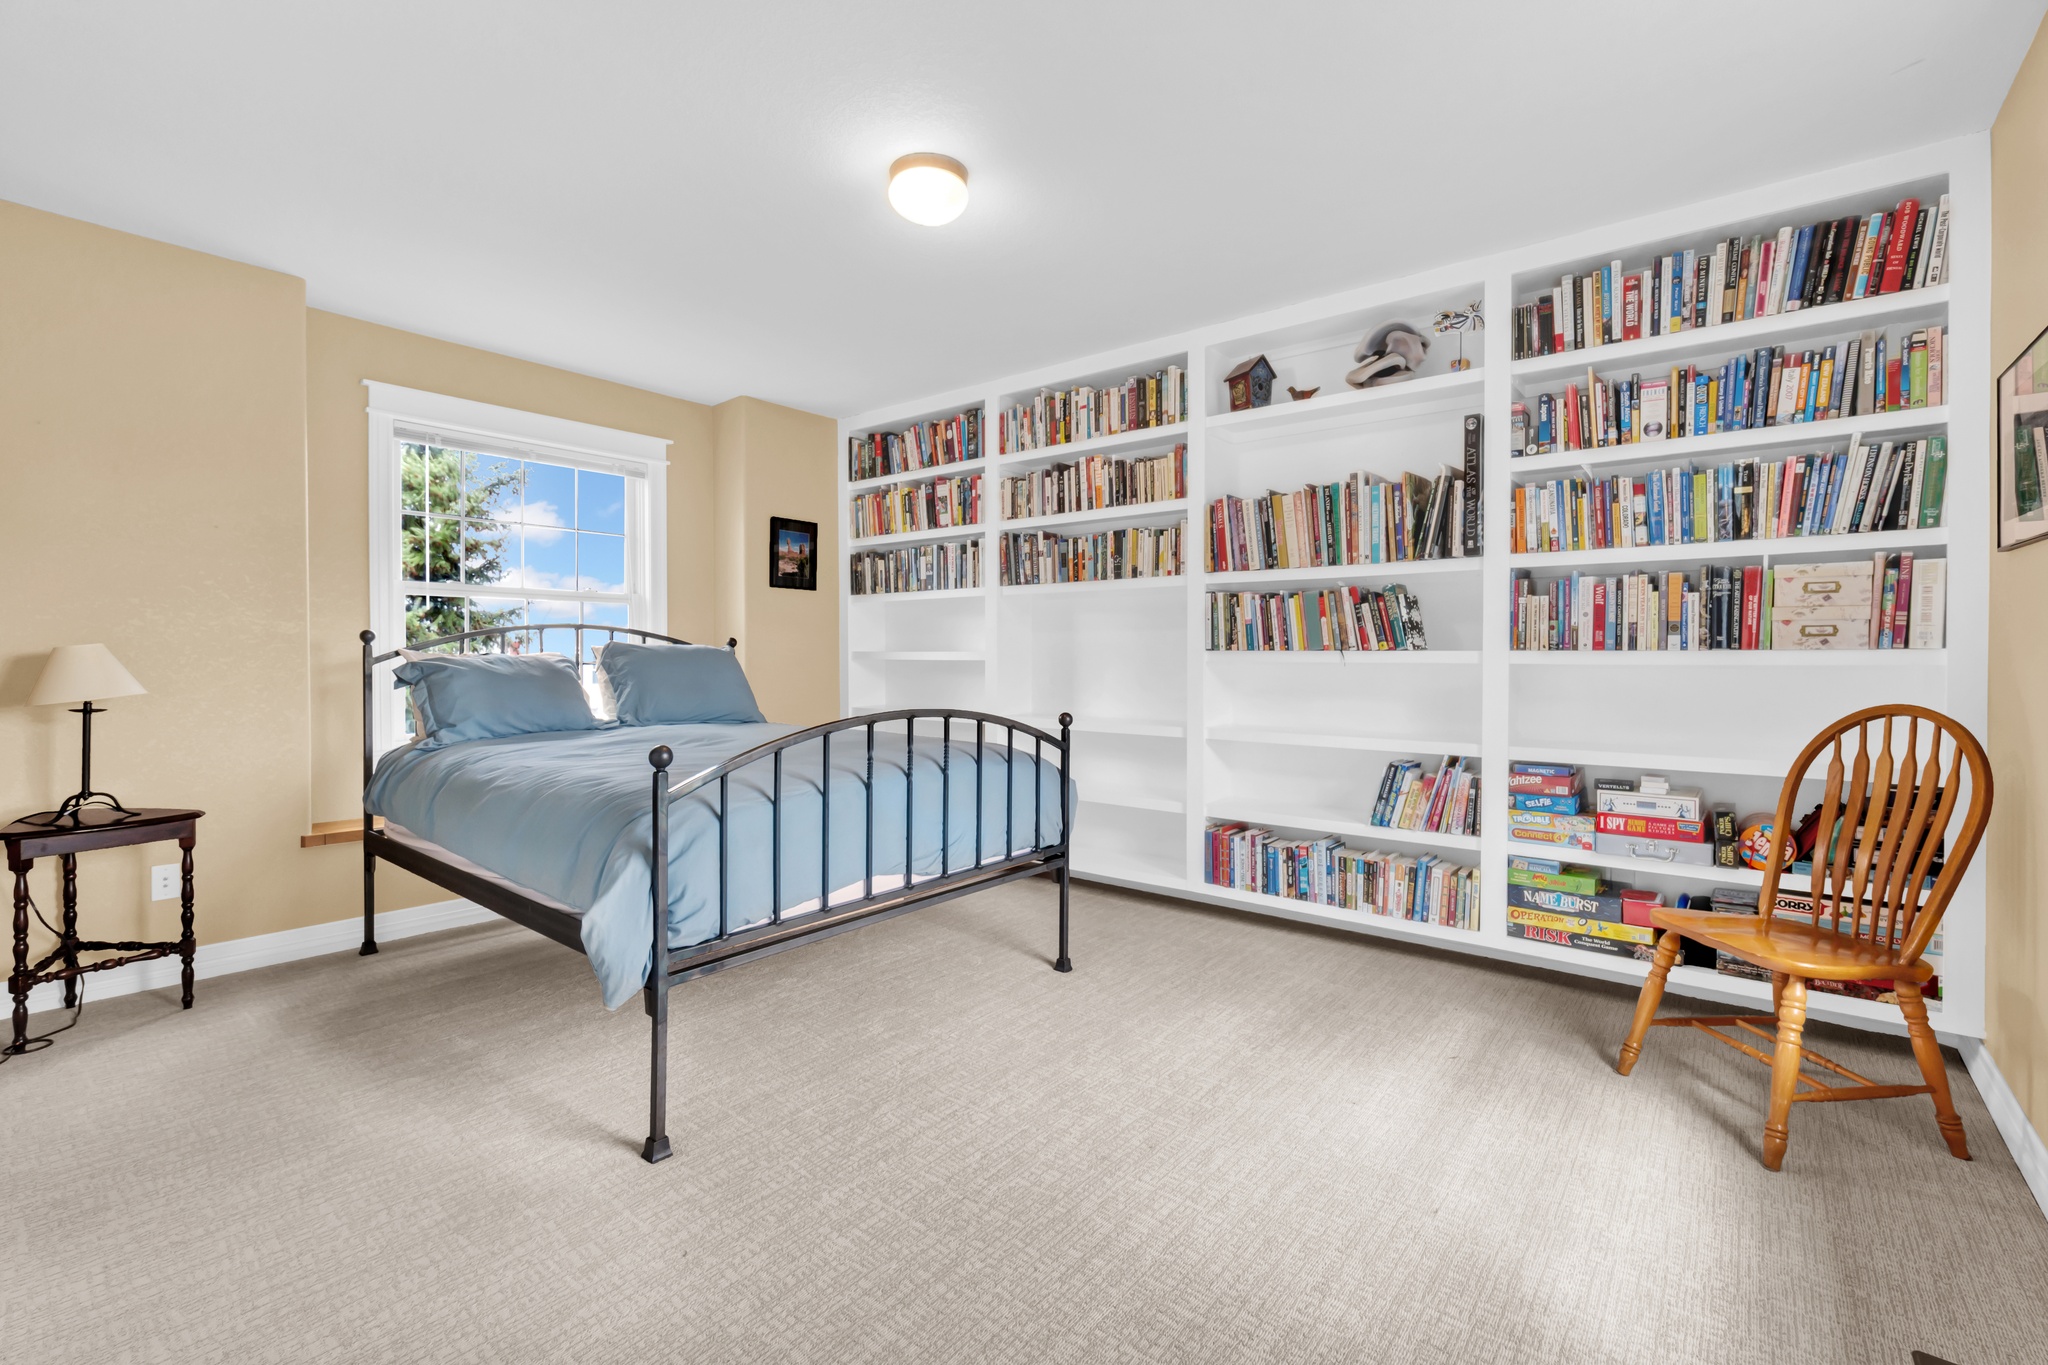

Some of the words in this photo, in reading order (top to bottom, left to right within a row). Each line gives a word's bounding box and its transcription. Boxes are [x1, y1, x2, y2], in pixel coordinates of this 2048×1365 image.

[1916, 212, 1924, 233] MICHAEL
[1896, 215, 1909, 251] WOODWARD
[1867, 236, 1876, 254] GOING
[1699, 257, 1707, 269] 102
[1861, 255, 1873, 275] PUBLIC
[1730, 262, 1738, 286] CONFLICT
[1698, 270, 1706, 301] MINUTES
[1626, 291, 1635, 302] THE
[1626, 304, 1635, 327] WORLD
[1865, 348, 1874, 369] Puerto
[1786, 369, 1795, 383] Italy
[1864, 370, 1873, 384] Rico
[1757, 387, 1765, 405] National
[1785, 384, 1793, 400] 2007
[1820, 378, 1828, 403] ZEALAND
[1540, 403, 1548, 421] Japan
[1906, 443, 1916, 462] Fishing
[1467, 447, 1476, 483] ATLAS
[1903, 462, 1913, 473] Dry
[1903, 473, 1912, 486] Flies
[1466, 499, 1476, 537] WORLD
[1901, 558, 1910, 580] WINE
[1595, 586, 1604, 605] Wolf
[1512, 813, 1551, 825] TROUBLE
[1606, 816, 1625, 831] SPY
[1515, 830, 1554, 840] Connect
[1556, 833, 1562, 841] 4
[1745, 831, 1793, 861] Jena
[1523, 890, 1558, 905] NAME
[1560, 893, 1599, 913] BURST
[1510, 909, 1564, 923] OPERATION
[1524, 925, 1572, 946] RISK
[1574, 939, 1600, 949] Conquest
[1860, 934, 1902, 945] MOLY
